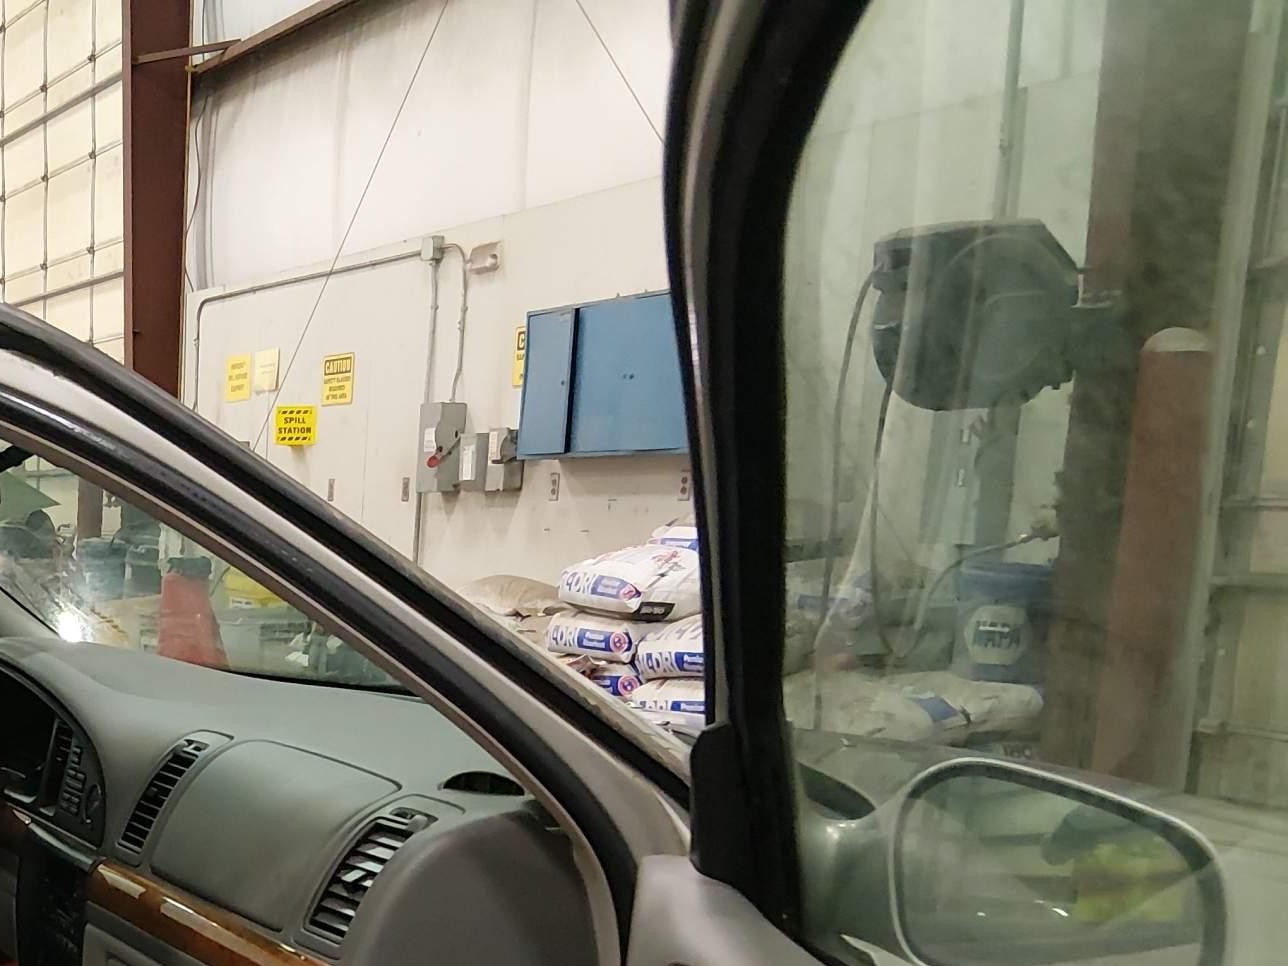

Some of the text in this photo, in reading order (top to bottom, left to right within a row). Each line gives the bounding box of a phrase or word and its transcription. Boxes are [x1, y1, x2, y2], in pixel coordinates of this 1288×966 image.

[325, 358, 352, 375] CAUTION
[283, 416, 306, 425] SPILL
[278, 426, 312, 435] STATION
